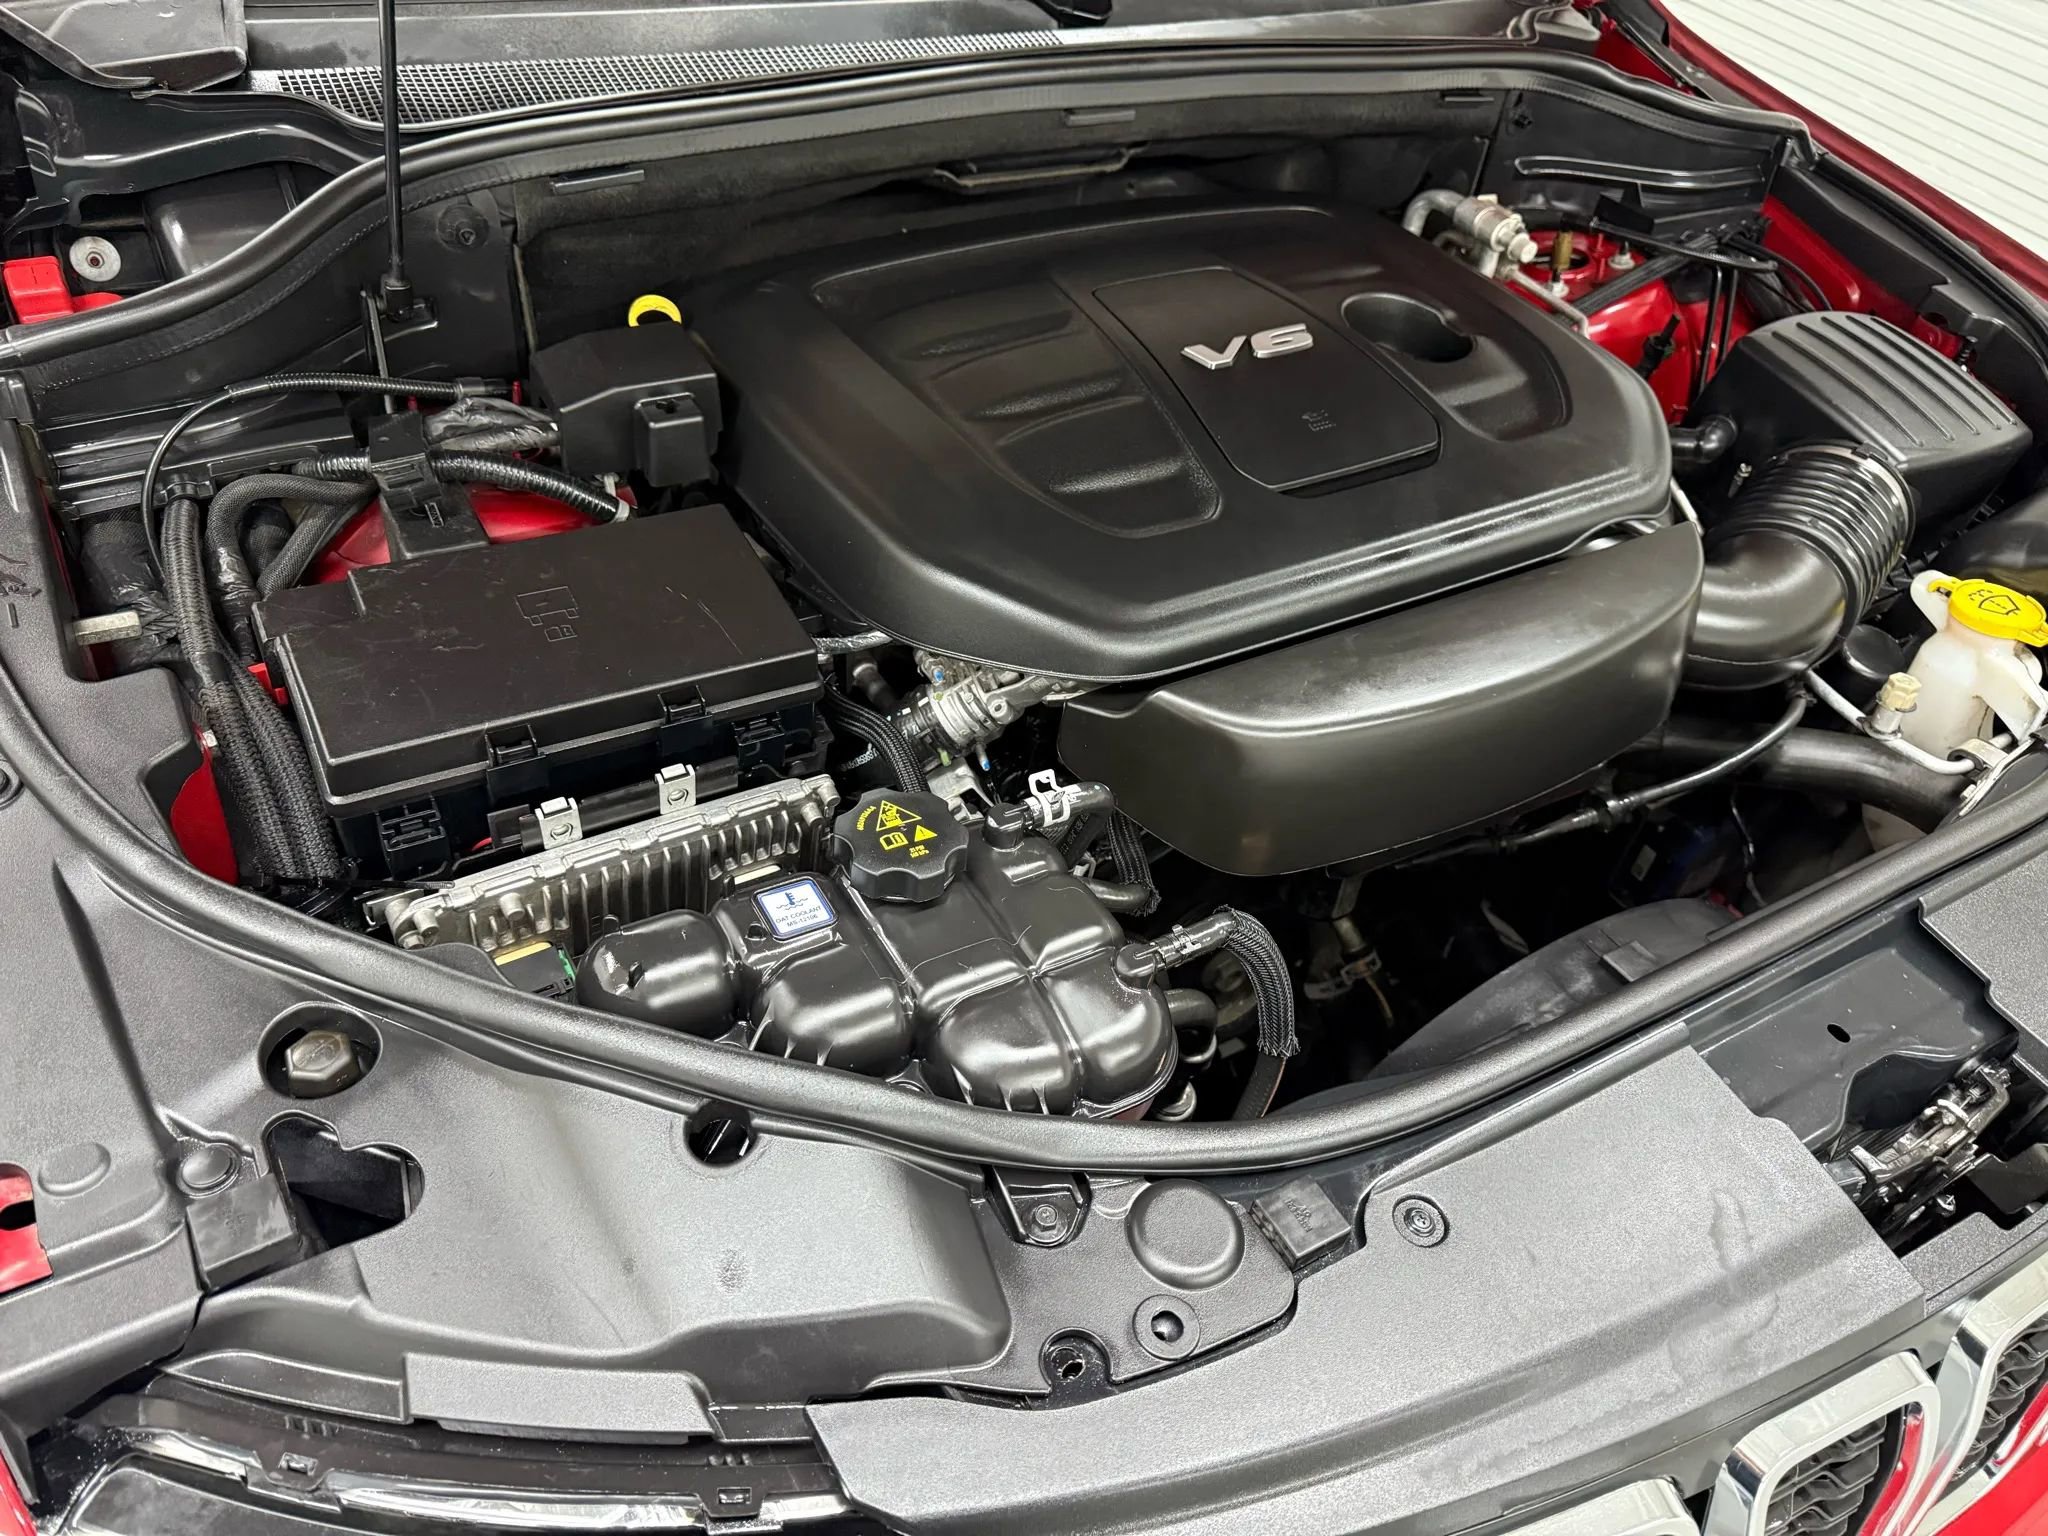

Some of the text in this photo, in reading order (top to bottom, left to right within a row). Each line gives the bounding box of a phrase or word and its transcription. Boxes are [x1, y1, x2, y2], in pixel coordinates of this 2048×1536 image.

[1180, 322, 1315, 370] V6
[775, 905, 821, 923] OAT COOLANT
